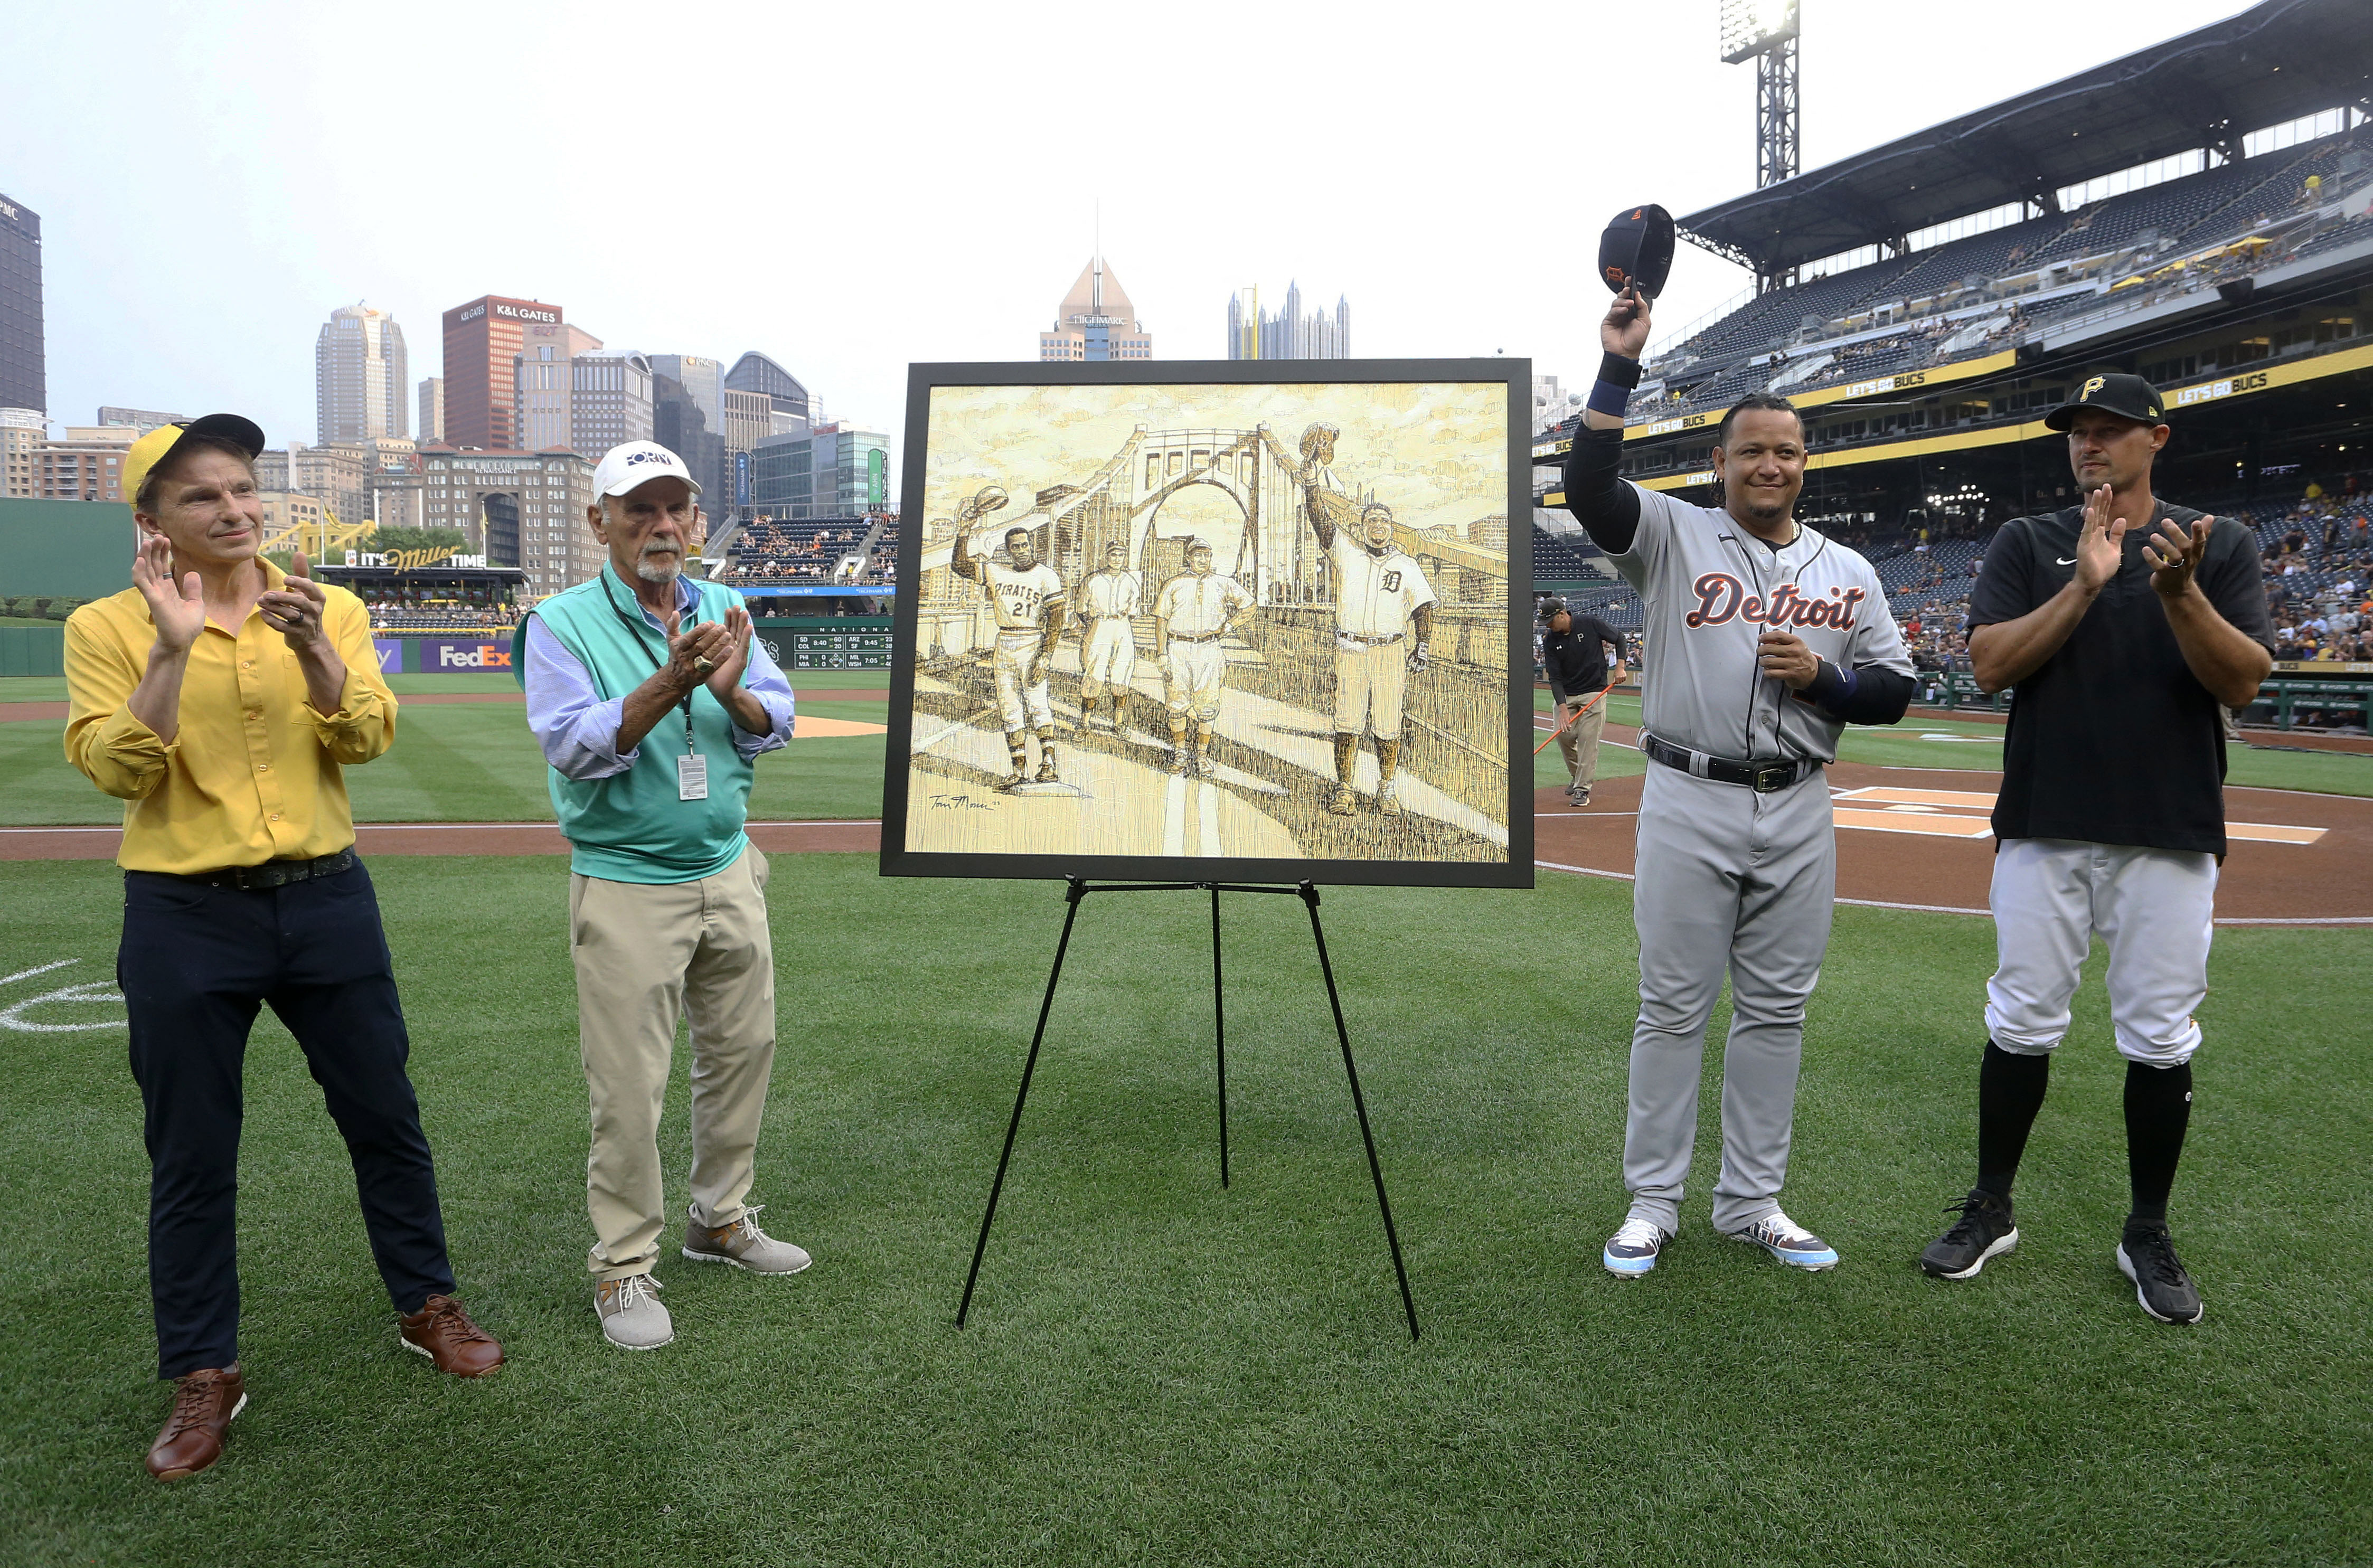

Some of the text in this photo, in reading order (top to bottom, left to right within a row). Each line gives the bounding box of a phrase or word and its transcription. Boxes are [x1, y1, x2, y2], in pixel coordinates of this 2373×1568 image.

[460, 305, 485, 322] K&L GATES
[497, 305, 555, 323] K&L GATES
[1074, 315, 1124, 325] HIGHMARK
[533, 325, 558, 336] EQT
[696, 358, 711, 367] PNC
[1846, 372, 1925, 397] LET'S GO BUCS
[2079, 376, 2107, 403] P
[2178, 373, 2267, 404] LET'S GO BUCS
[1648, 414, 1706, 434] LET'S GO BUCS
[1532, 439, 1572, 457] ET'S GO BUCS
[1687, 473, 1707, 485] LET'S
[361, 545, 486, 575] IT'S Miller TIME
[1379, 568, 1402, 593] D
[994, 583, 1040, 604] PIRATES
[1685, 571, 1866, 632] Detroit
[1012, 602, 1031, 617] 21
[1577, 633, 1584, 643] P
[440, 646, 512, 667] FedEx
[929, 795, 952, 810] Tom
